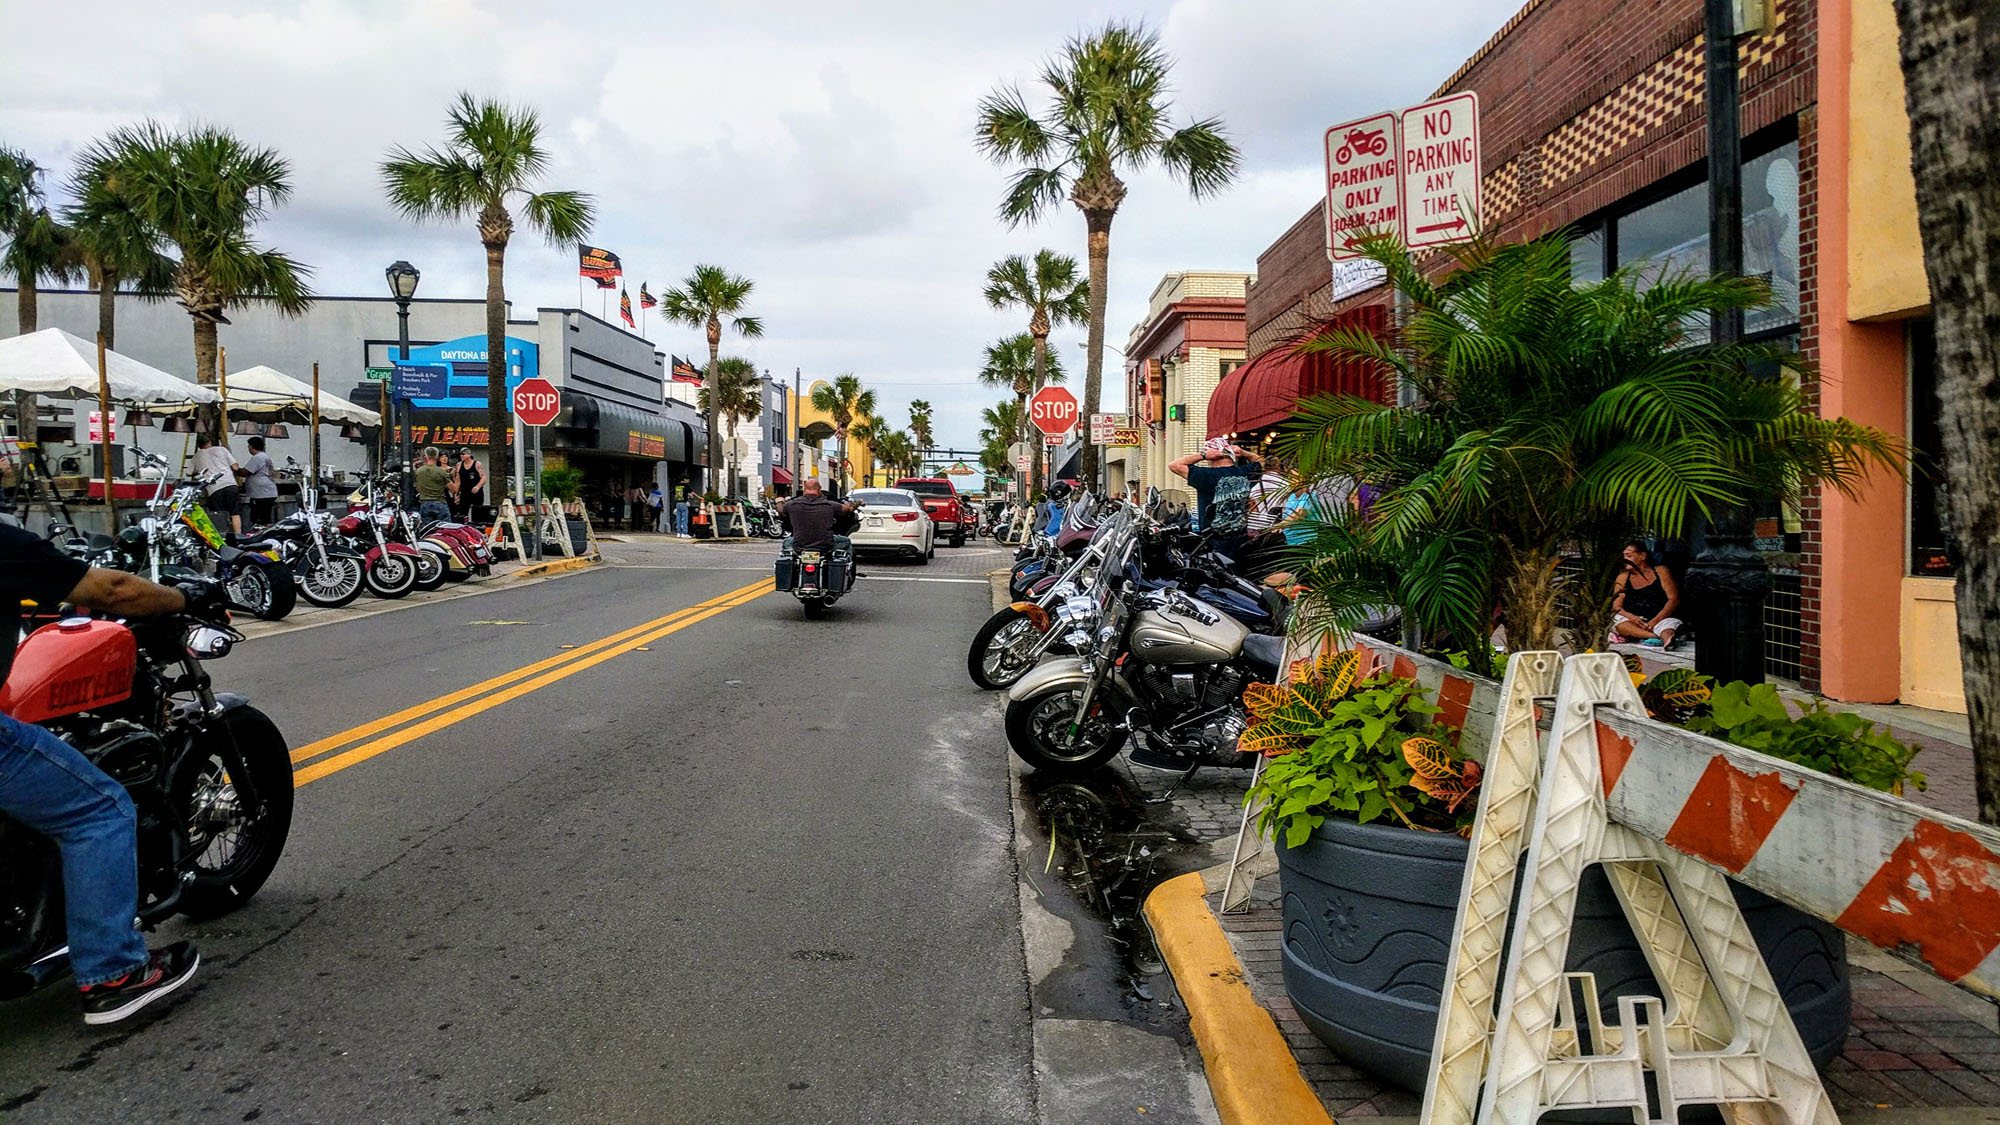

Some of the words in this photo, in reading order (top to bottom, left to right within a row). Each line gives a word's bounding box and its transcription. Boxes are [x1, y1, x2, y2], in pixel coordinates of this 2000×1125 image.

[1424, 109, 1452, 139] NO
[1407, 137, 1472, 175] PARKING
[1332, 159, 1395, 189] PARKING
[1425, 171, 1455, 193] ANY
[1345, 186, 1383, 210] ONLY
[1423, 193, 1458, 216] TIME
[1334, 206, 1397, 232] 10AM-2AM
[441, 351, 479, 360] DAYTONA
[516, 392, 557, 411] STOP
[1033, 401, 1075, 419] STOP
[394, 426, 428, 443] HT
[432, 427, 515, 445] LEATHES
